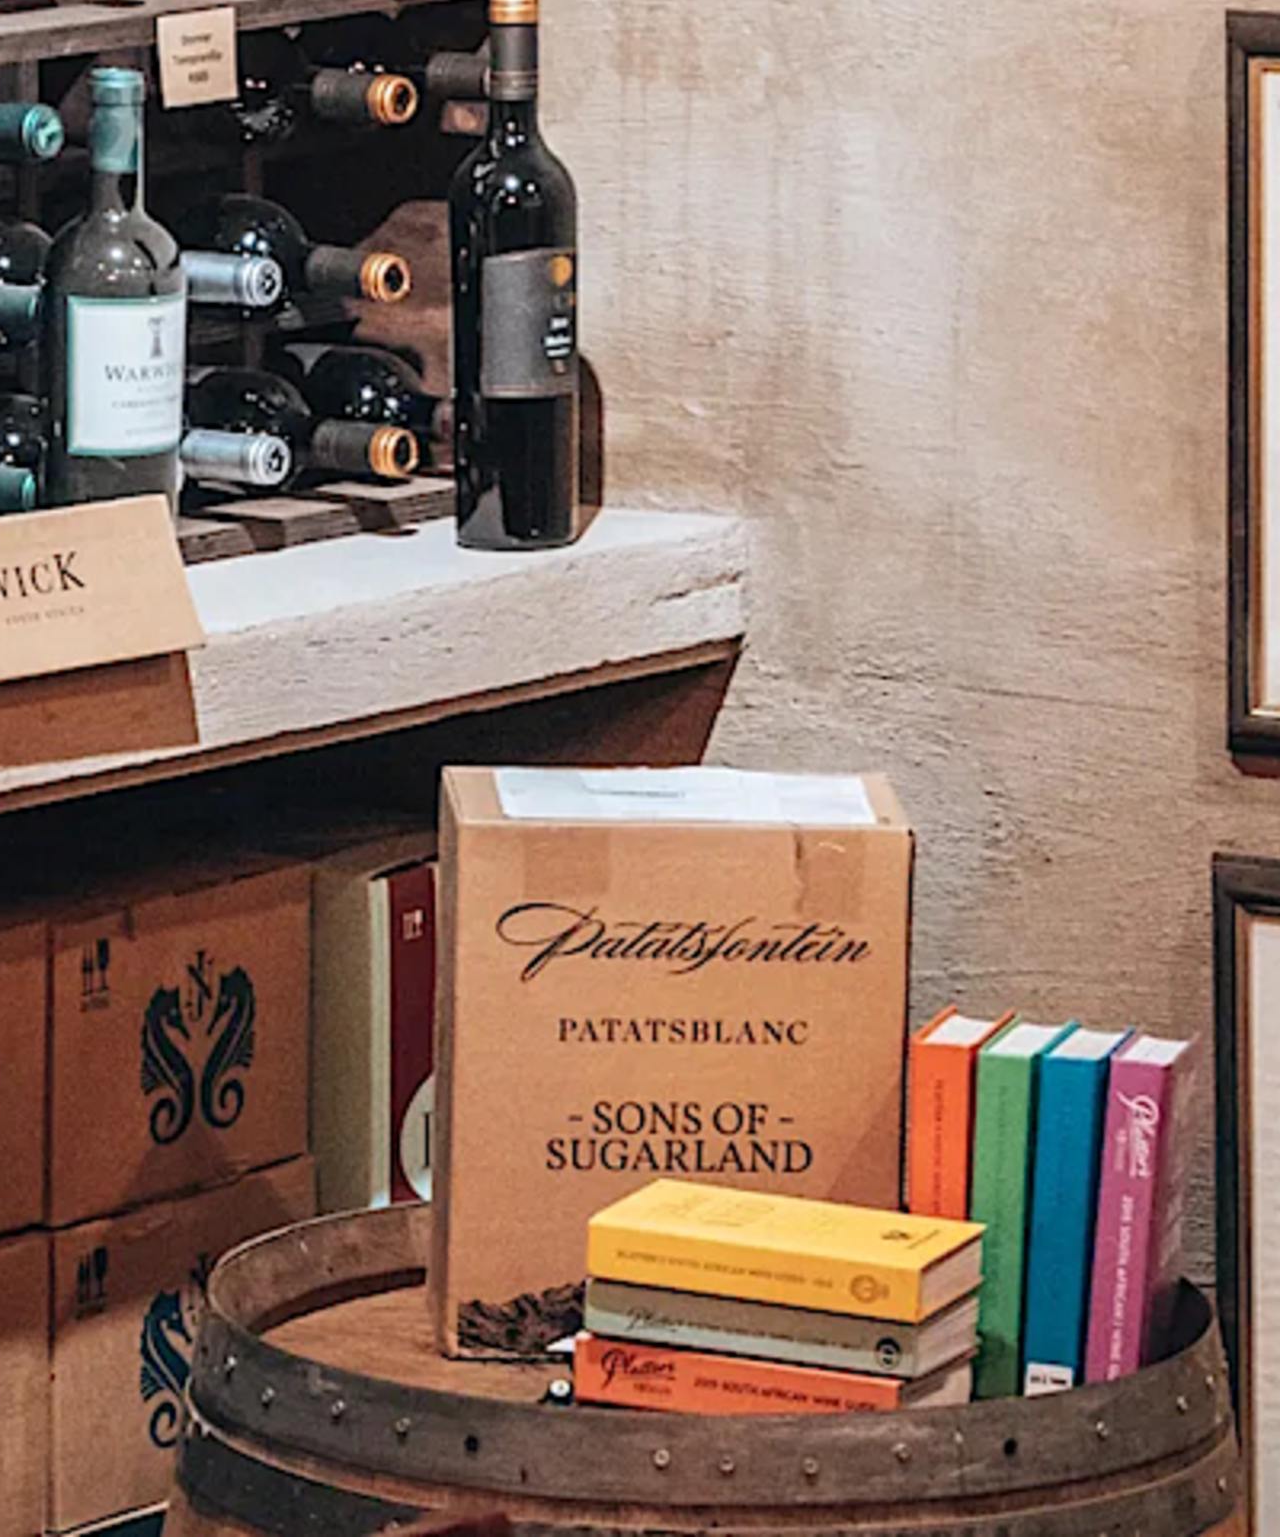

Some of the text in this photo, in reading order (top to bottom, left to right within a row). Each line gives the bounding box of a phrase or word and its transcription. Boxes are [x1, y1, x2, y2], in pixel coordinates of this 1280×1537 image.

[557, 1017, 809, 1045] PATATSBLANC
[591, 1101, 767, 1136] SONS OF
[545, 1138, 814, 1175] SUGARLAND
